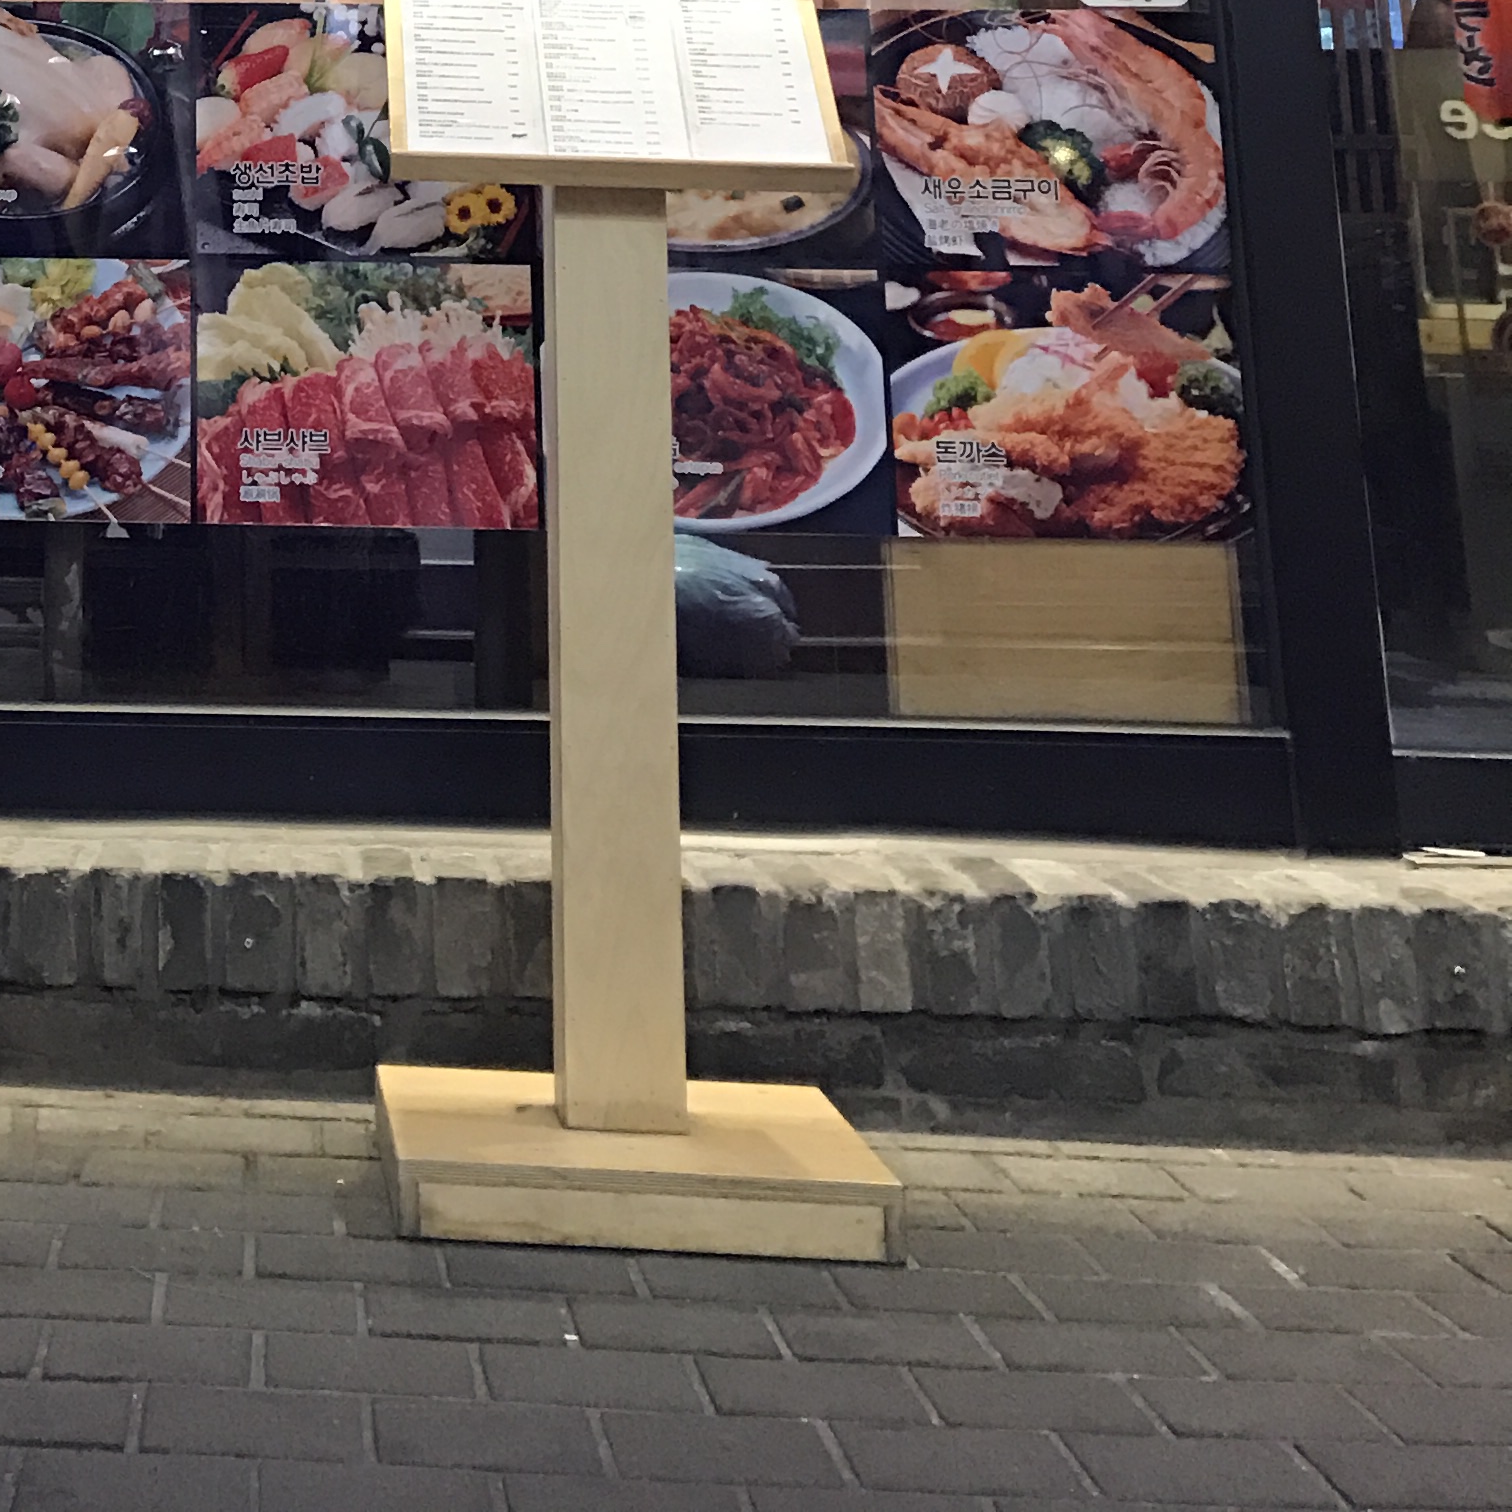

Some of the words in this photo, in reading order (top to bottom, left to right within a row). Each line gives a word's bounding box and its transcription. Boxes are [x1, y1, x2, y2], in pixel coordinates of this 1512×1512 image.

[231, 161, 323, 187] 생선초밥
[921, 177, 1061, 201] 새우소금구이
[238, 428, 330, 453] 샤브샤브
[936, 440, 1006, 464] 돈까스
